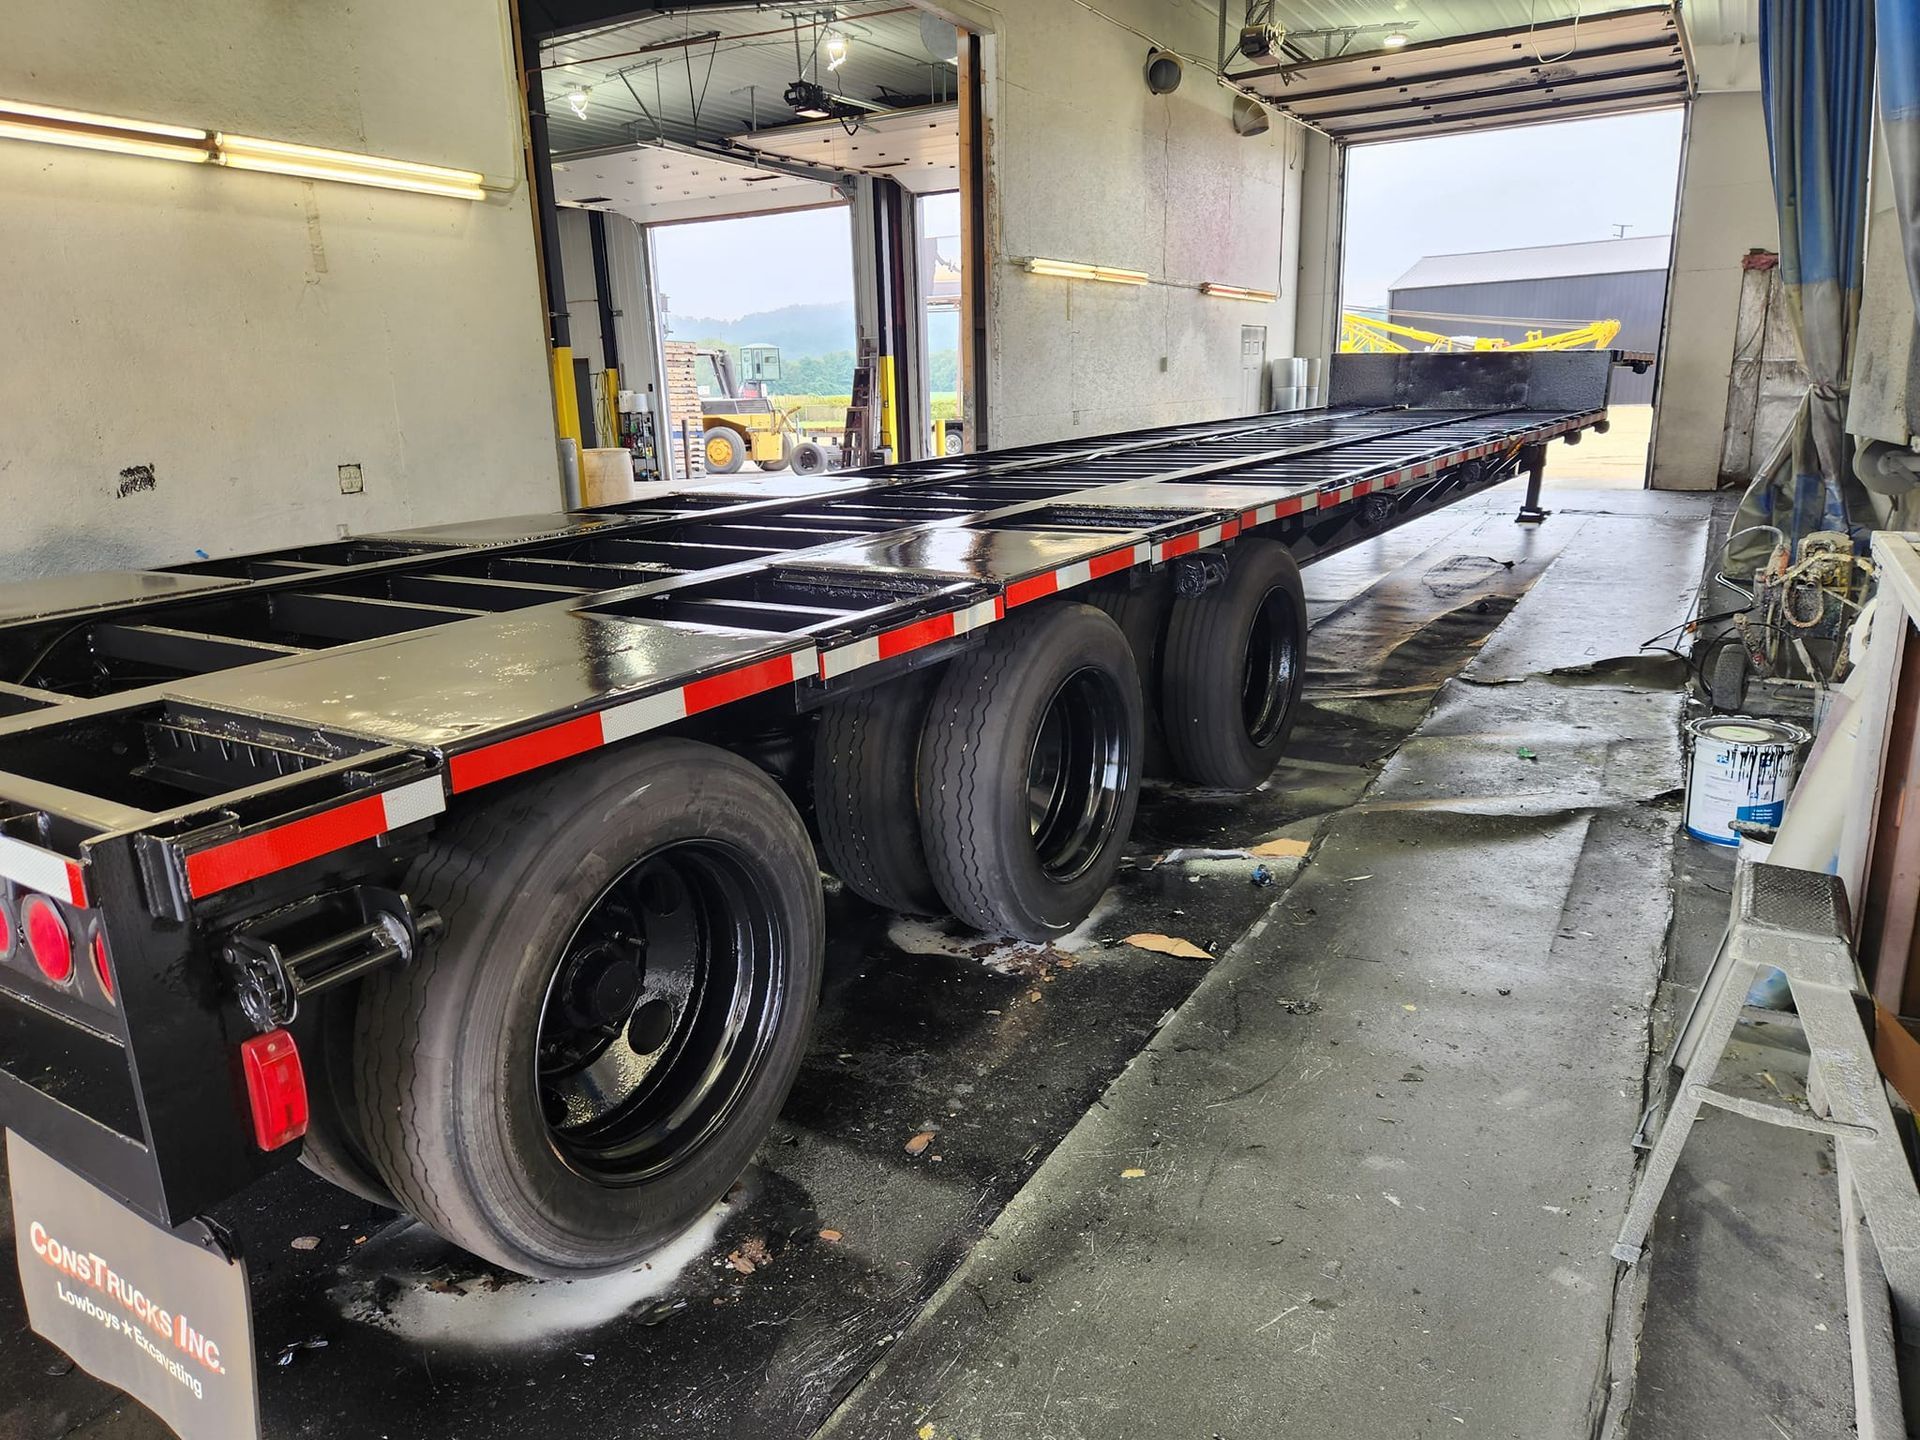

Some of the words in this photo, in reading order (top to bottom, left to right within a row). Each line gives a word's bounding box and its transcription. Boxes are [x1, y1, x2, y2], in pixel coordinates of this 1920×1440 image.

[57, 1281, 120, 1330] Lowboys
[133, 1326, 203, 1400] Excavating
[174, 1314, 226, 1375] INC.
